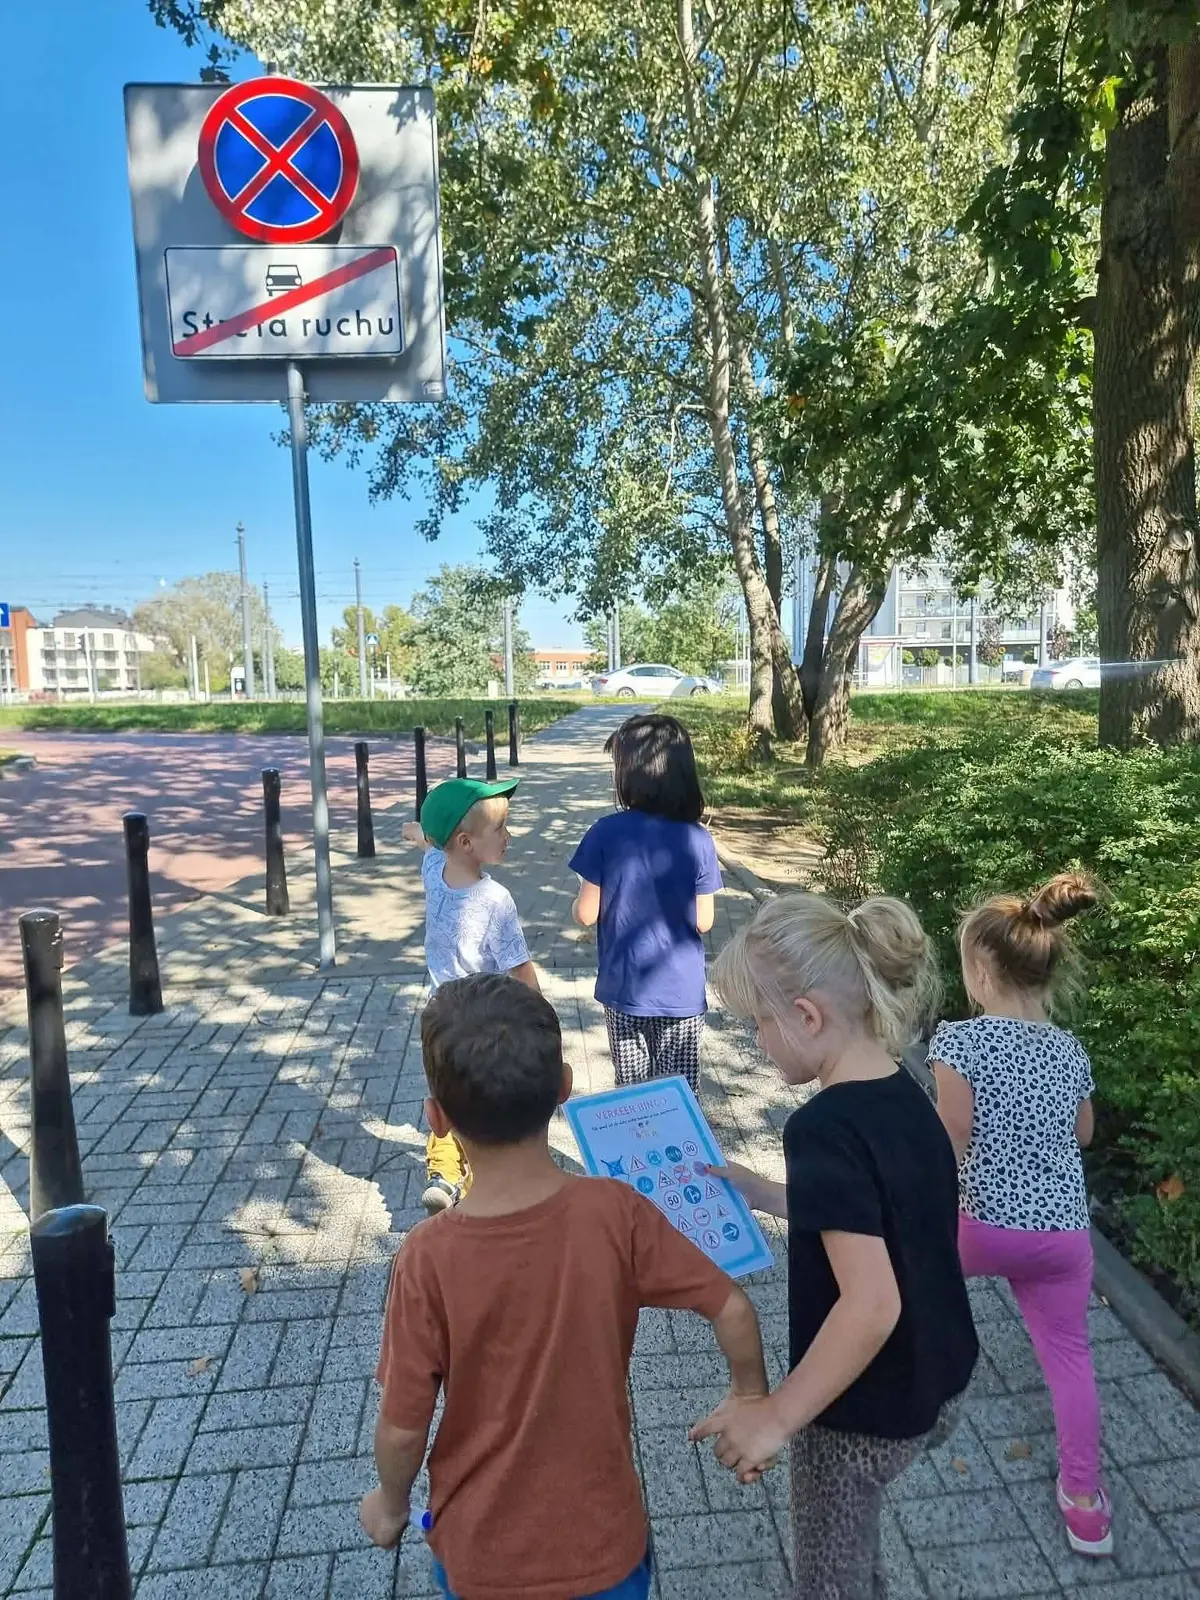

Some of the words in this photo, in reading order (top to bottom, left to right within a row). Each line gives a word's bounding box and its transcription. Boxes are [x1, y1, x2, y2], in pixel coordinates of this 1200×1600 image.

[182, 310, 288, 338] Sta
[303, 310, 393, 337] ruchu
[667, 1194, 680, 1206] 50
